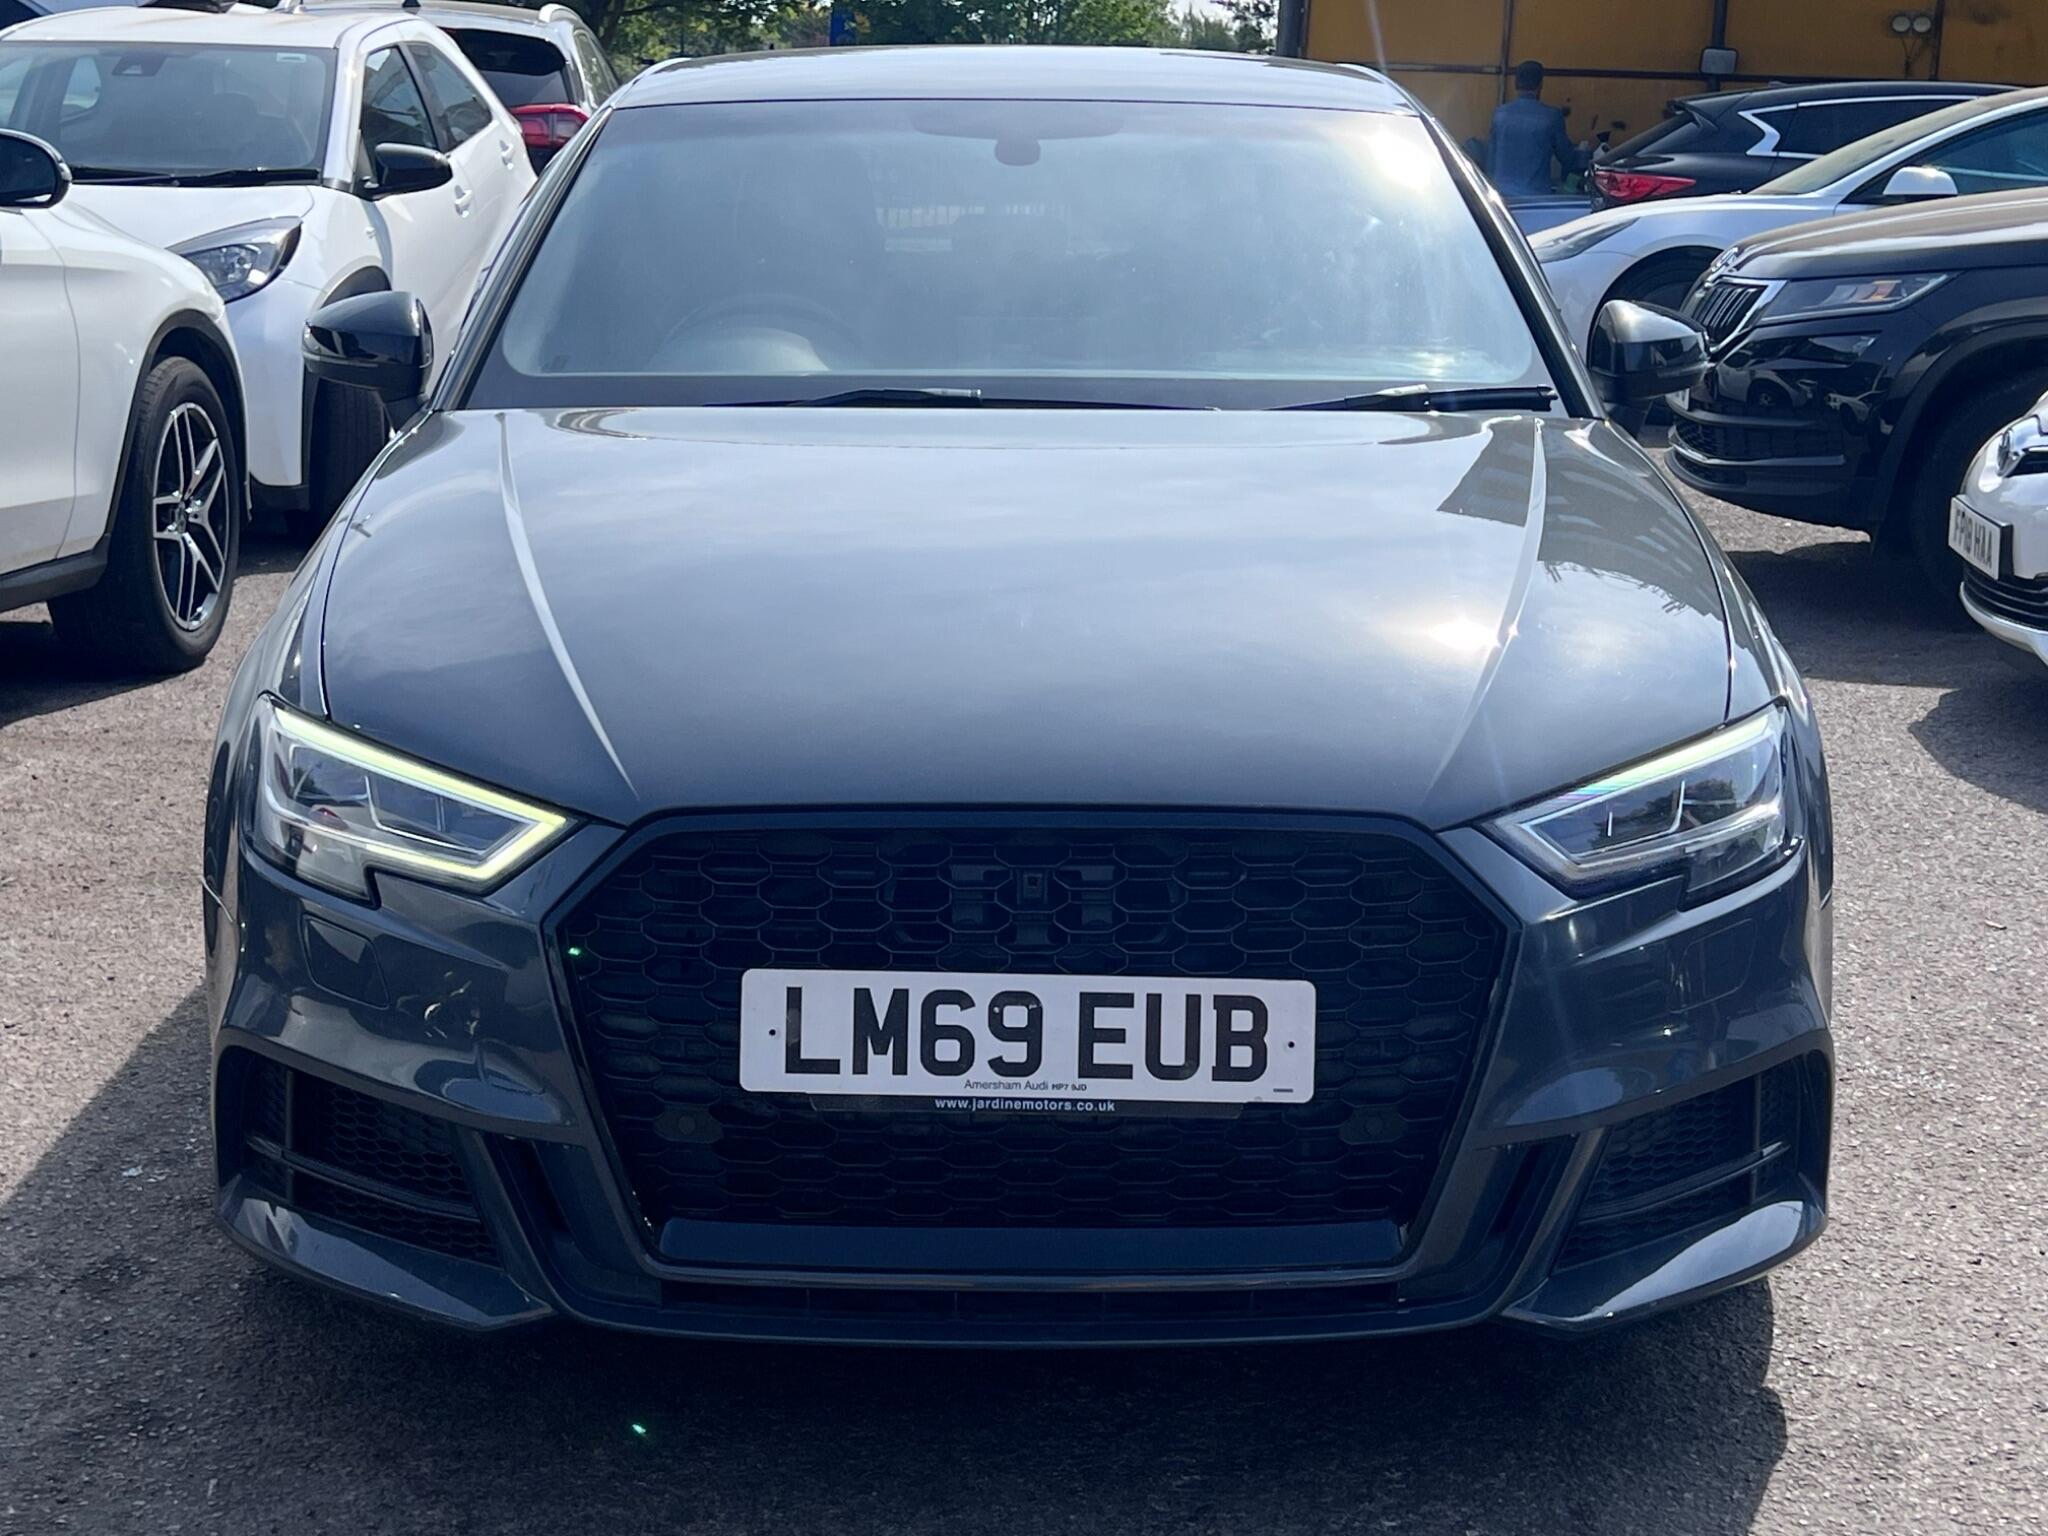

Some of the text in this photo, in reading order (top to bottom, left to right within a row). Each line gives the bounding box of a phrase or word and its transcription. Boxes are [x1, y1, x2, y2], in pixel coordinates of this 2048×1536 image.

[785, 986, 1268, 1082] LM69 EUB
[964, 1079, 1021, 1090] Amersham
[1024, 1080, 1048, 1090] Audi
[934, 1098, 1115, 1112] www.jardinemotors.co.uk
